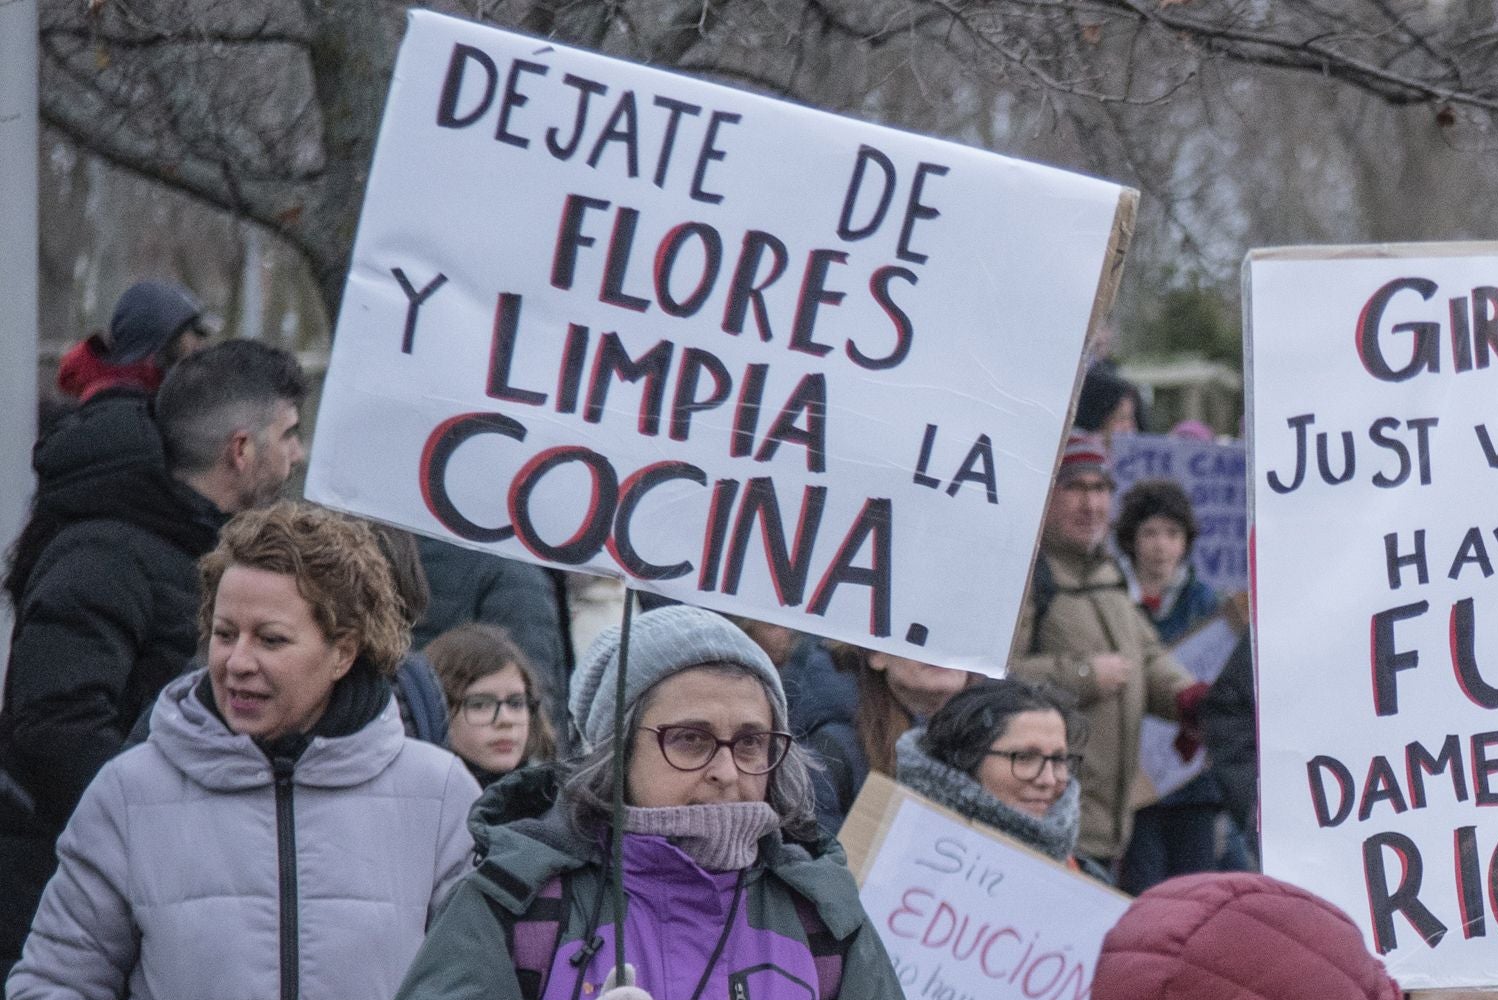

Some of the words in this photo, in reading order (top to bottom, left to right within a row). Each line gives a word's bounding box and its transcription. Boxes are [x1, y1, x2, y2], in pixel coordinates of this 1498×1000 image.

[437, 43, 742, 203] DÉJATE
[836, 144, 950, 264] DE
[550, 193, 918, 370] FLORES
[390, 266, 447, 354] Y
[485, 292, 826, 473] LIMPIA
[912, 424, 999, 504] LA
[1267, 413, 1438, 493] JUST
[419, 412, 928, 647] COCINA.
[914, 836, 1005, 896] Sin
